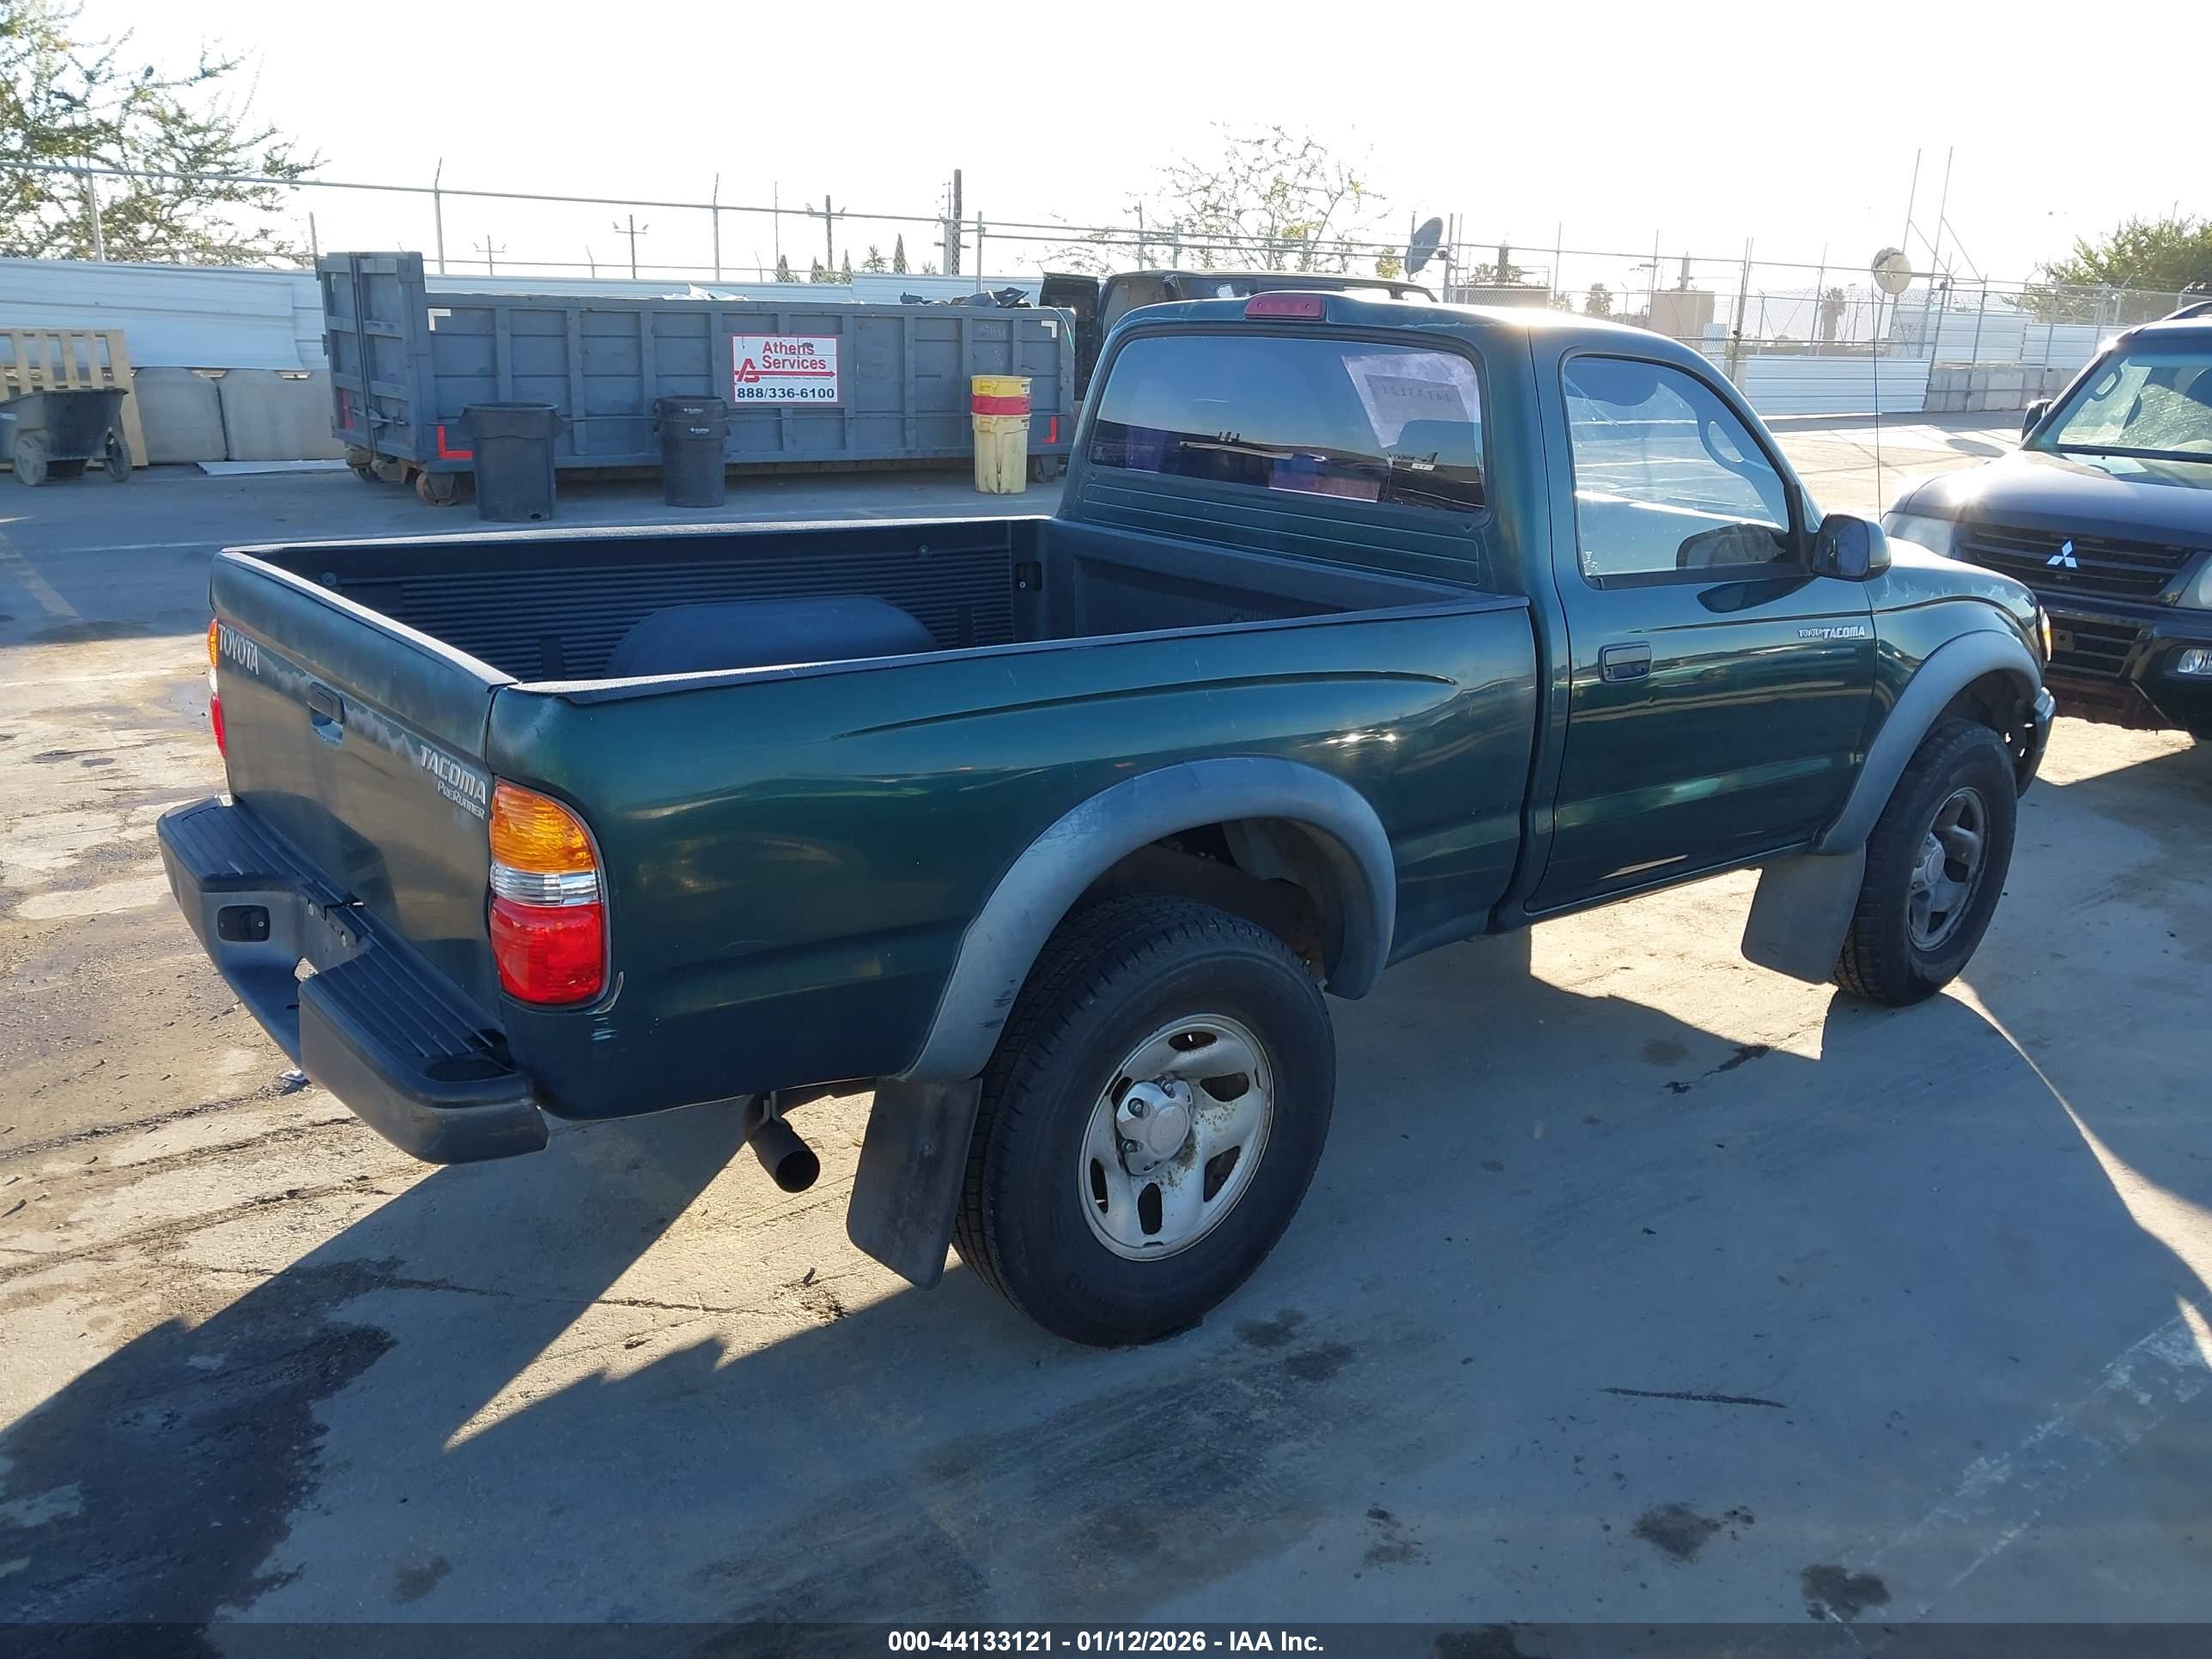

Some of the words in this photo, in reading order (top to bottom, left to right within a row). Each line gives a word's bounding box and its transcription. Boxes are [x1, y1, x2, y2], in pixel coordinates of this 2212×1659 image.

[763, 341, 815, 355] Athens
[763, 355, 826, 369] Services
[737, 387, 835, 398] 888/336-6100
[1821, 626, 1865, 639] TACOMA
[218, 623, 259, 676] TOYOTA
[420, 744, 486, 805] TACOMA
